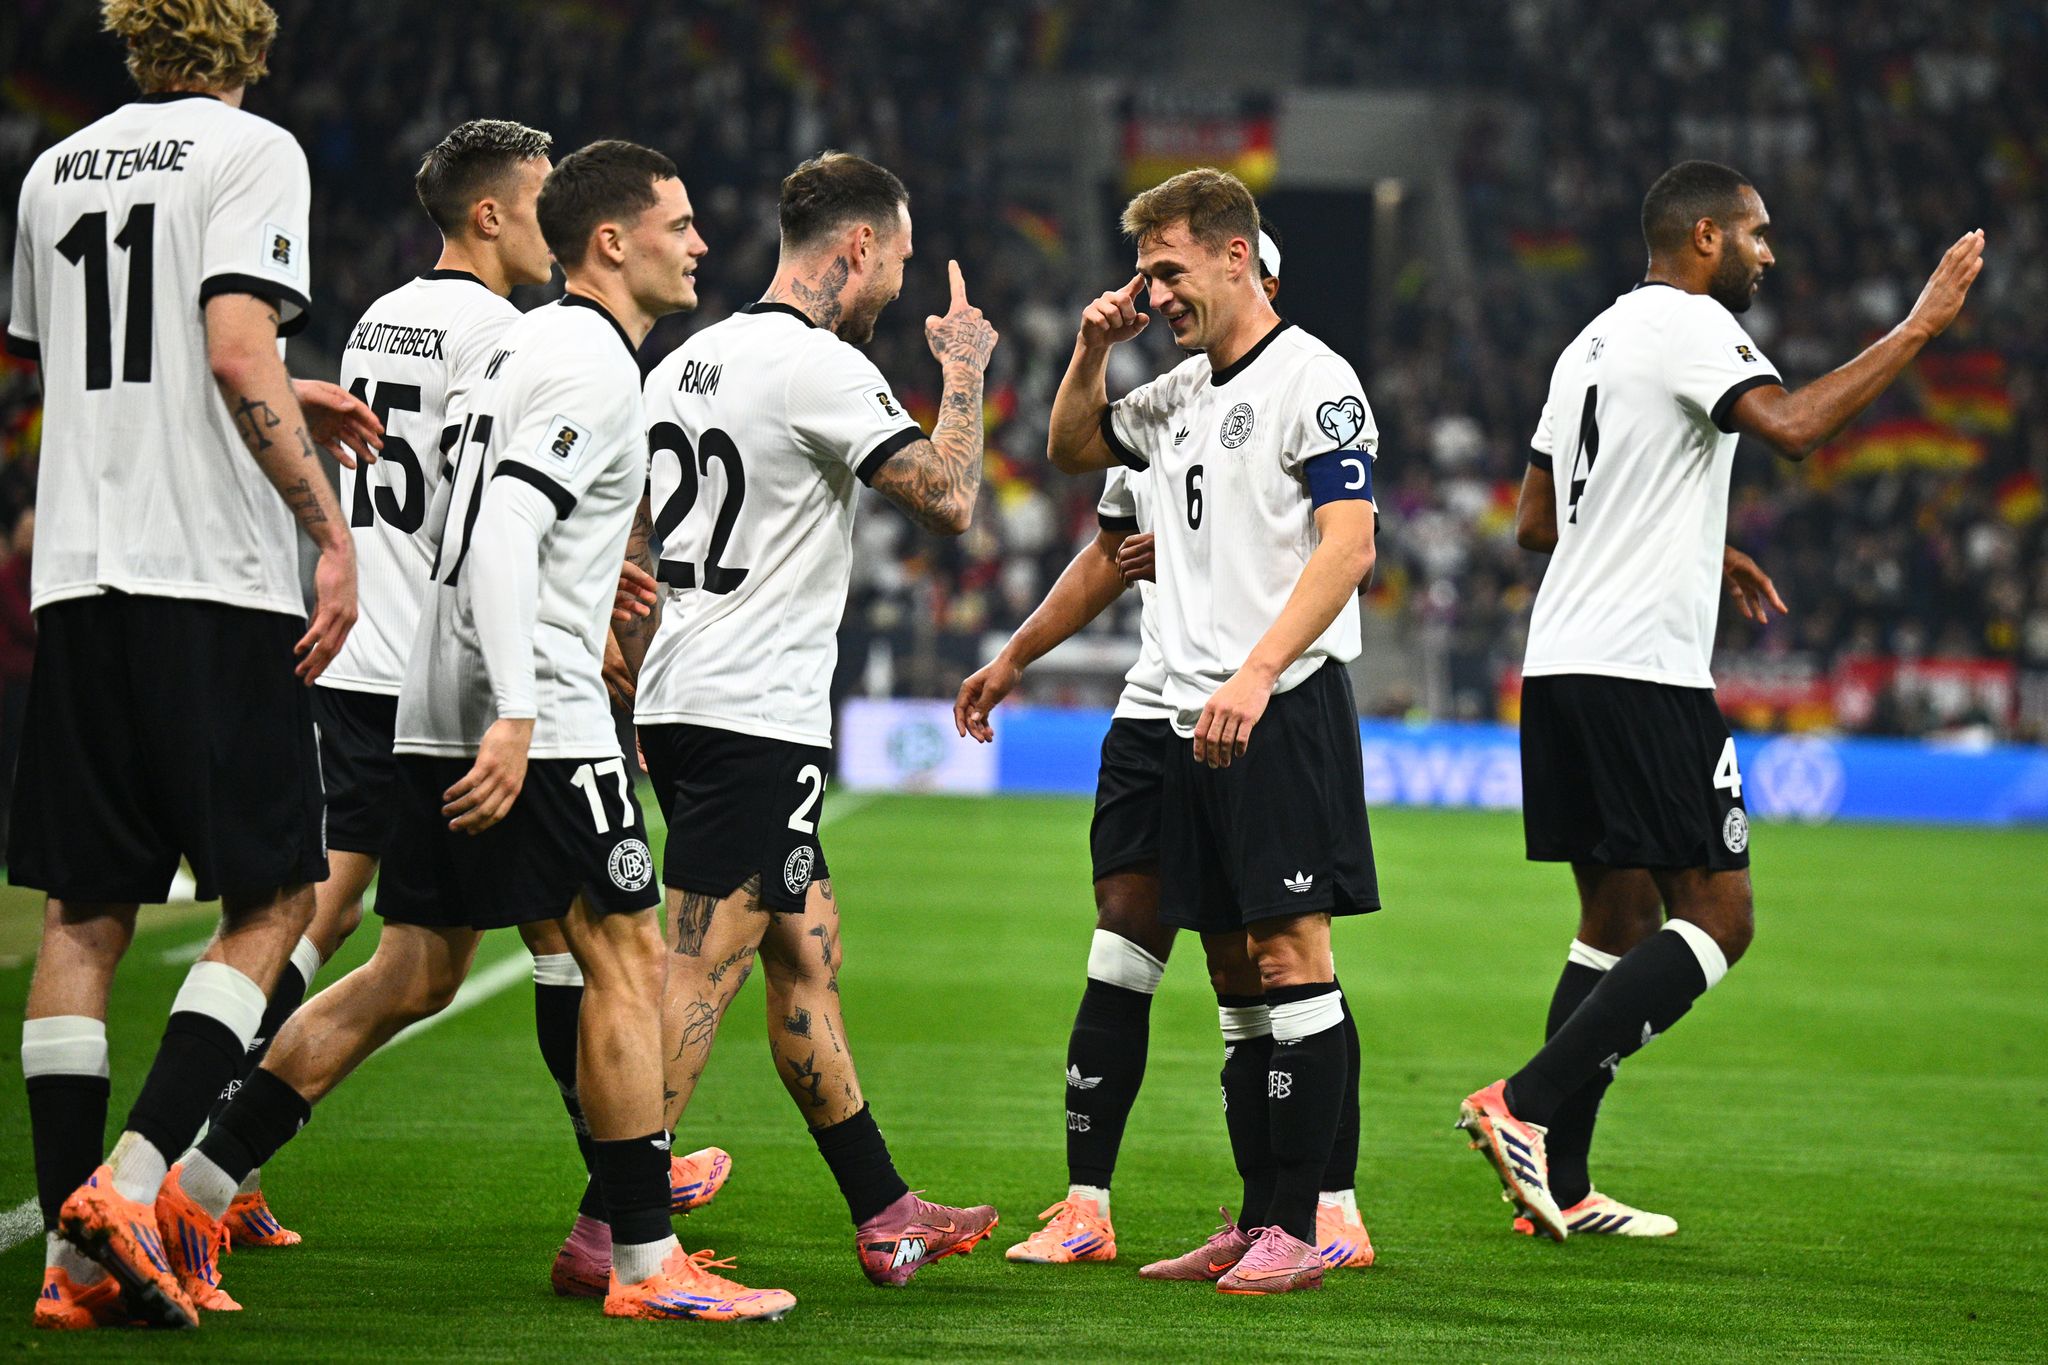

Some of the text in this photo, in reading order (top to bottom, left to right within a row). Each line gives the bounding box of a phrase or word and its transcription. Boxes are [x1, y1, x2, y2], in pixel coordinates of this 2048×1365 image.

[54, 203, 155, 391] 11
[349, 376, 425, 534] 15
[649, 421, 750, 595] 22
[1185, 464, 1204, 530] 6
[570, 757, 635, 834] 17
[788, 764, 829, 837] 2
[1713, 737, 1742, 798] 4
